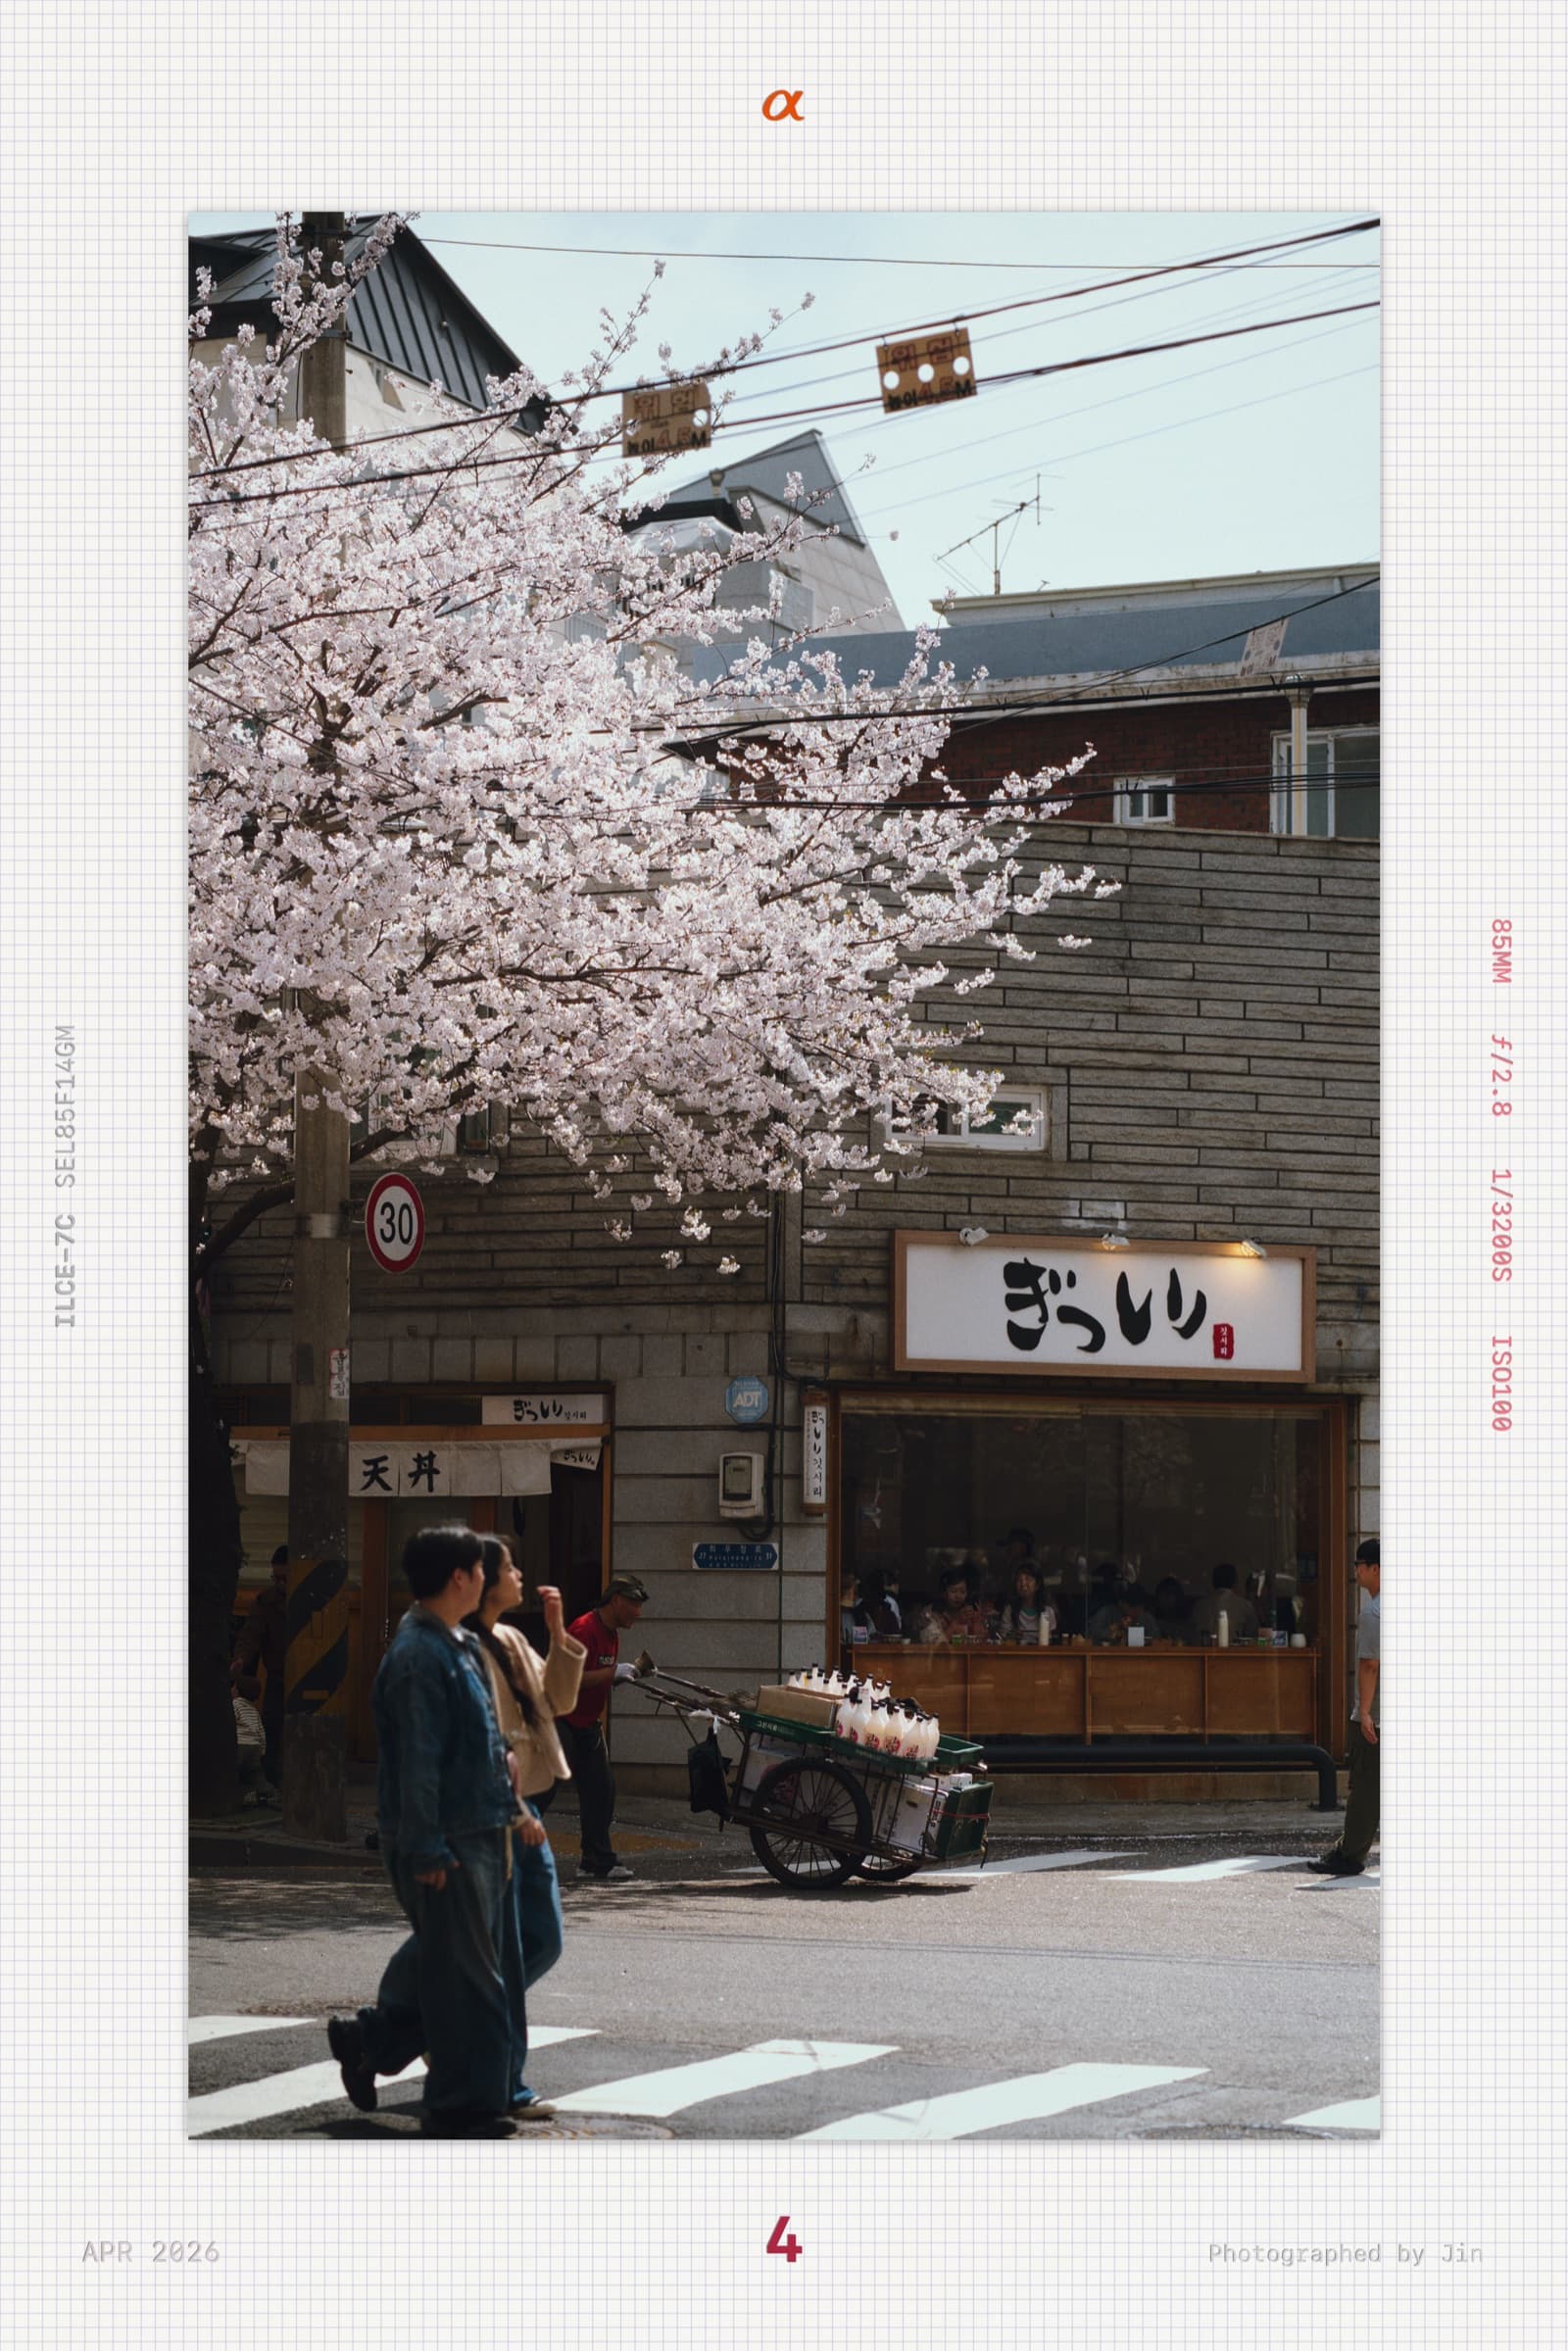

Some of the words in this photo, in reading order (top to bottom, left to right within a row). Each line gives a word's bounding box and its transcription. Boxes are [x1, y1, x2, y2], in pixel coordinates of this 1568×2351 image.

[380, 1201, 413, 1245] 30
[1003, 1256, 1207, 1353] ぎっしり
[733, 1392, 761, 1408] ADT
[360, 1450, 440, 1493] 天丼
